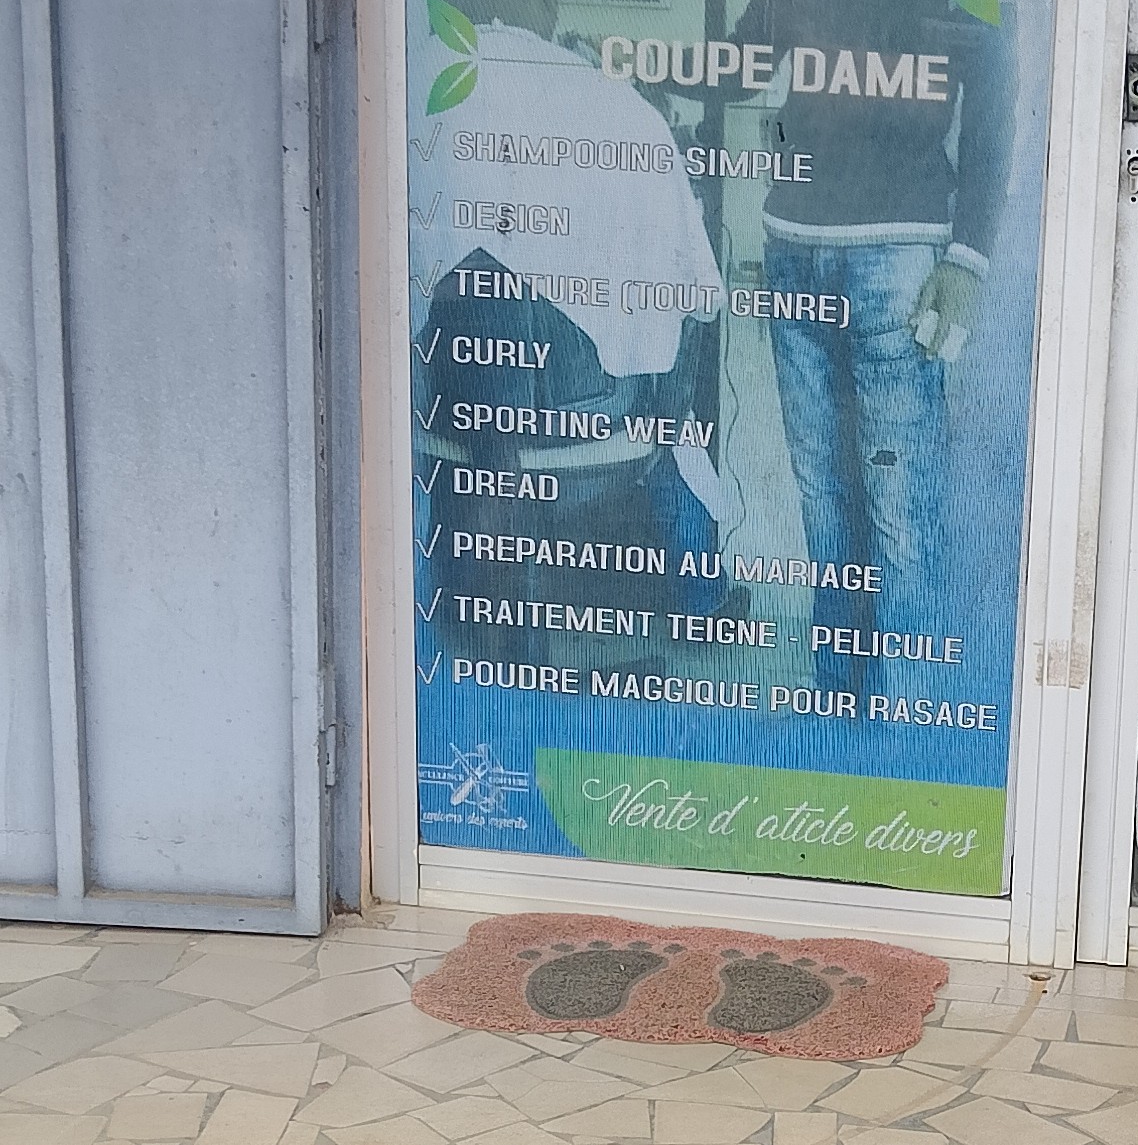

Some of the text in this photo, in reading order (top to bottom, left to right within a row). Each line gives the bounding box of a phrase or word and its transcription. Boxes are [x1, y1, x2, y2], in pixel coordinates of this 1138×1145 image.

[600, 36, 950, 103] COUPE DAME
[453, 130, 814, 184] SHAMPOOING SIMPLE
[453, 200, 571, 236] DESIGN
[453, 268, 851, 329] TEINTURE (TOUT GENRE)
[452, 336, 551, 369] CURLY
[452, 402, 714, 448] SPORTING WEAV
[453, 467, 560, 501] DREAD
[453, 531, 883, 593] PREPARATION AU MARIAGE
[453, 594, 655, 638] TRAITEMENT
[666, 613, 777, 648] TEIGNE
[811, 625, 963, 664] PELICULE
[453, 657, 998, 732] POUDRE MAGGIQUE POUR RASAGE
[581, 778, 708, 832] Vente
[864, 810, 981, 859] divers
